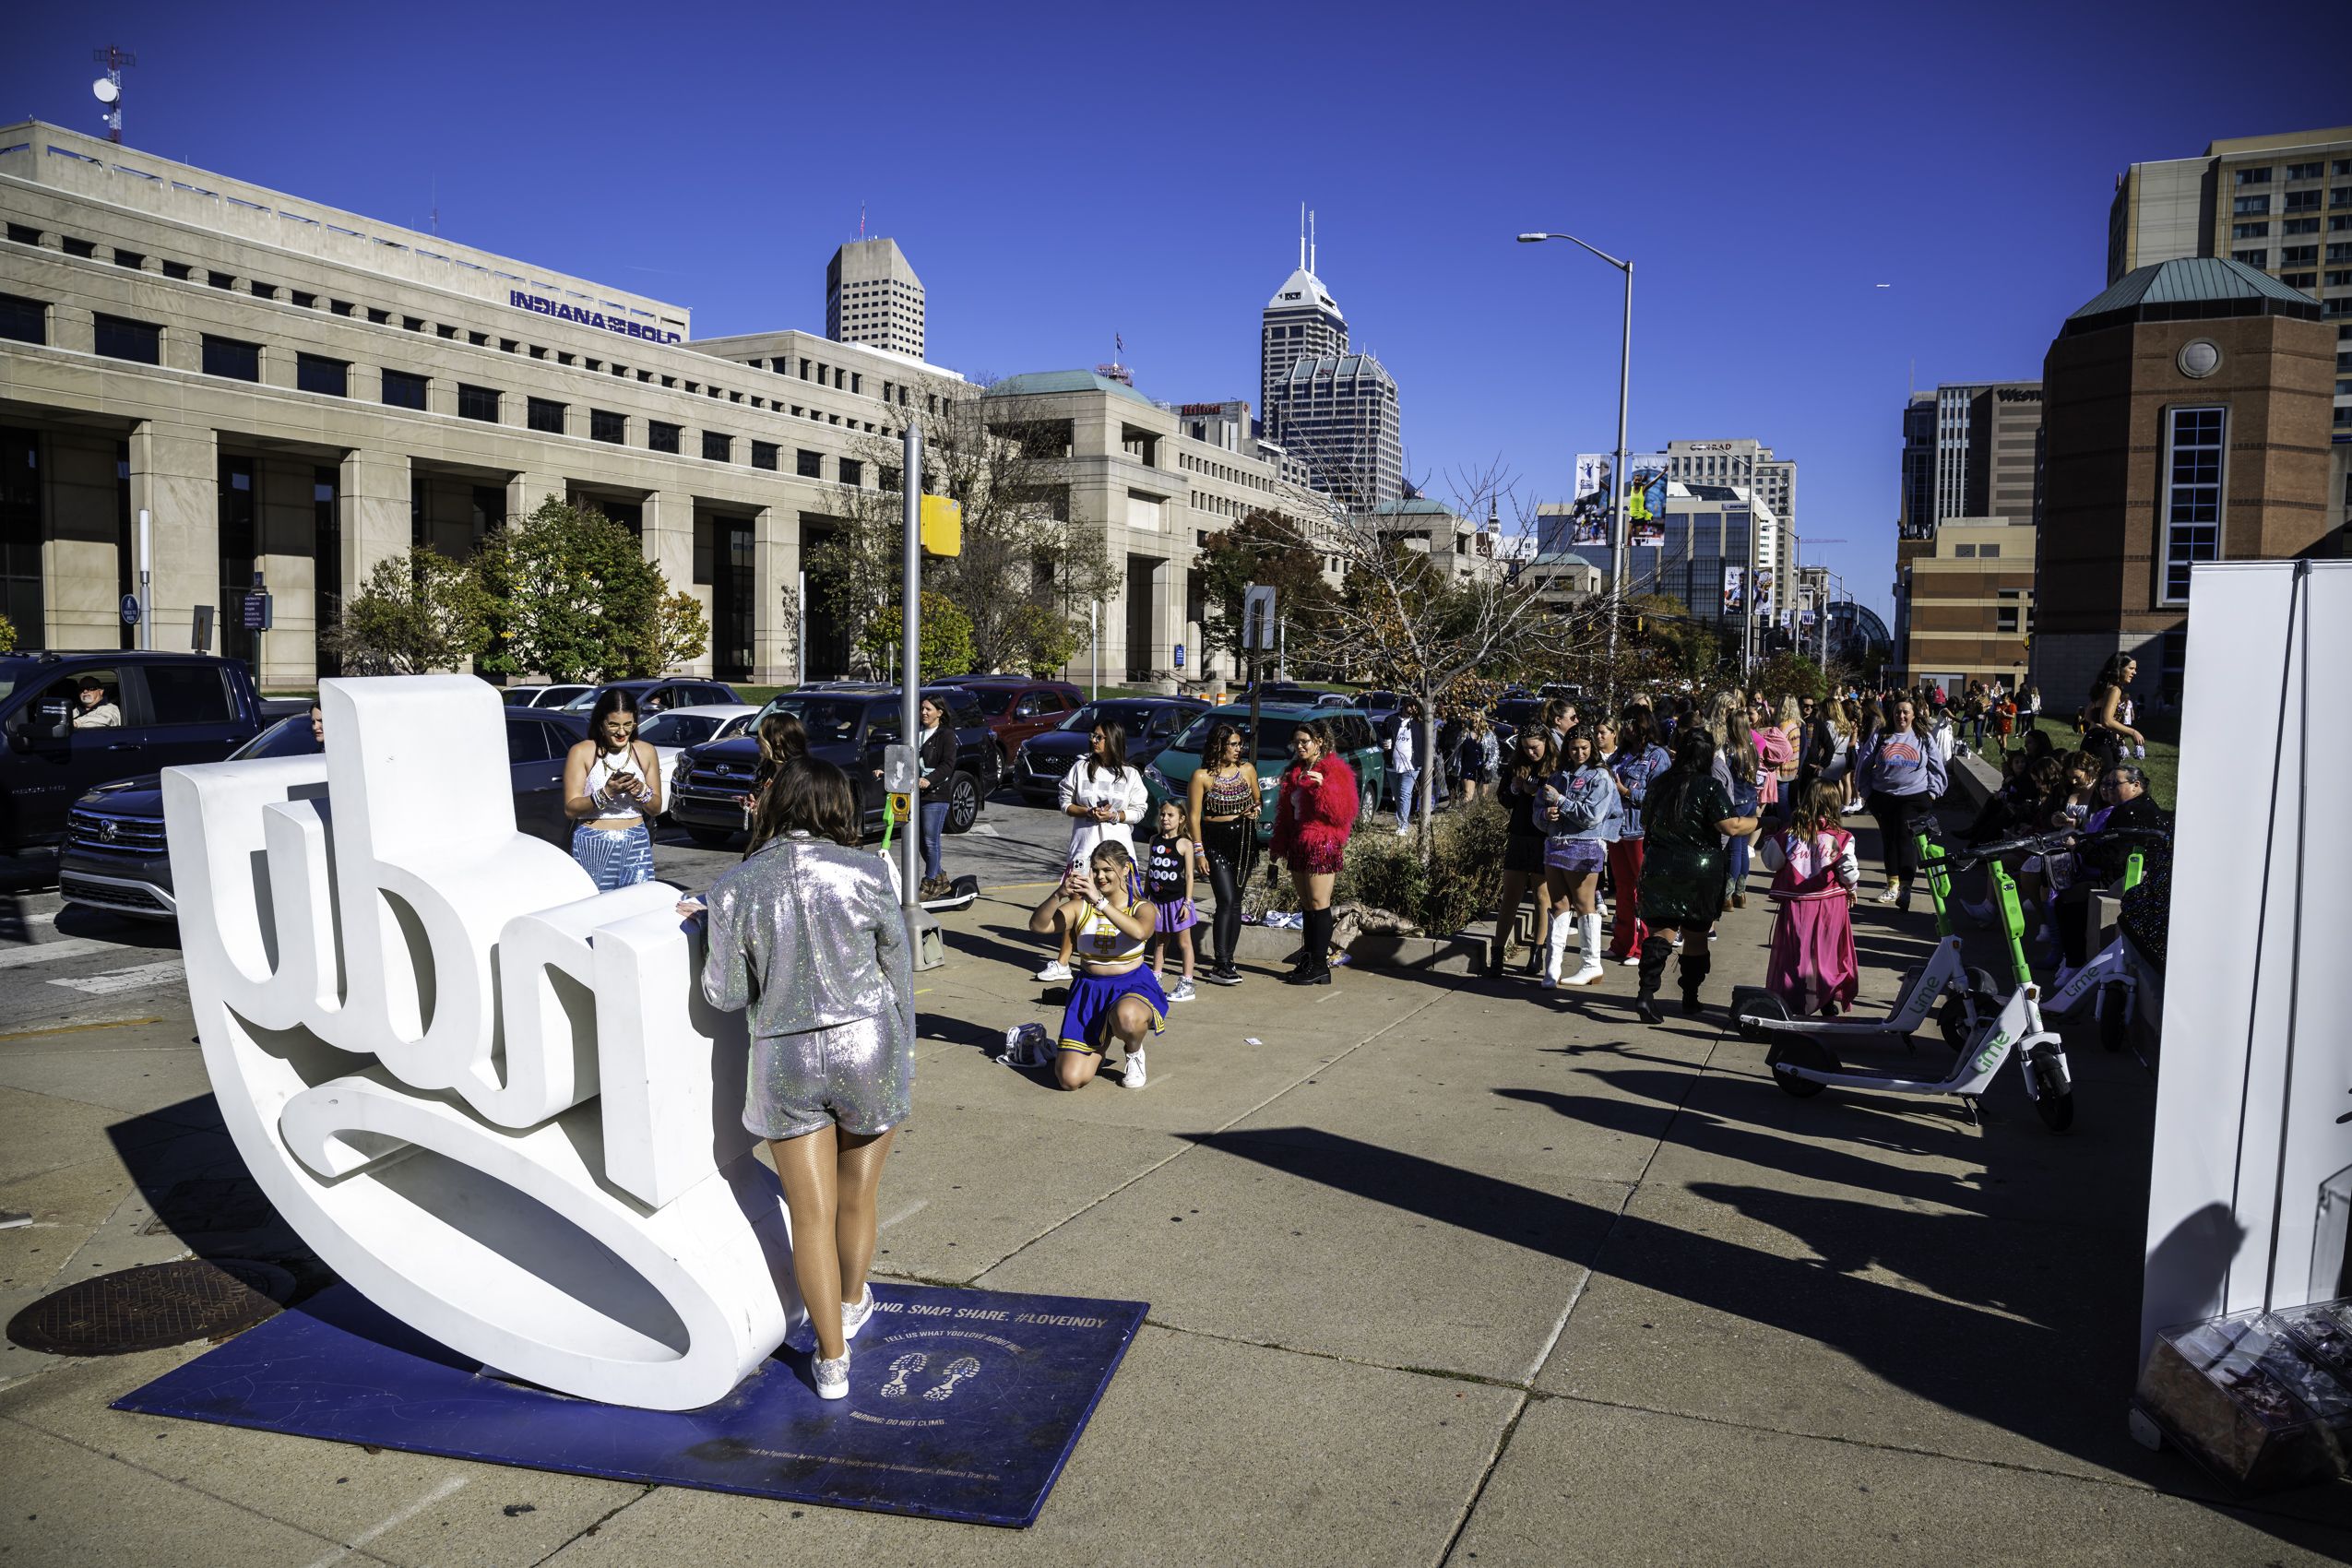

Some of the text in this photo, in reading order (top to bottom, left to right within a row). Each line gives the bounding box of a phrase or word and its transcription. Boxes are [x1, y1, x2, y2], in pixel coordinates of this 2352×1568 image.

[510, 290, 606, 329] INDIANA
[608, 316, 626, 327] FOR
[627, 322, 681, 344] BOLD
[1690, 443, 1732, 451] CONRAD
[2065, 966, 2099, 997] Lime
[1909, 976, 1940, 1015] Lime
[1970, 1030, 2011, 1075] Lime
[908, 1304, 950, 1317] SNAP.
[954, 1308, 1009, 1322] SHARE.
[1014, 1313, 1108, 1328] #LOVEINDY
[885, 1334, 904, 1343] TELL
[964, 1331, 986, 1339] LOVE
[983, 1335, 1011, 1347] ABOUT
[936, 1467, 967, 1478] Cultural
